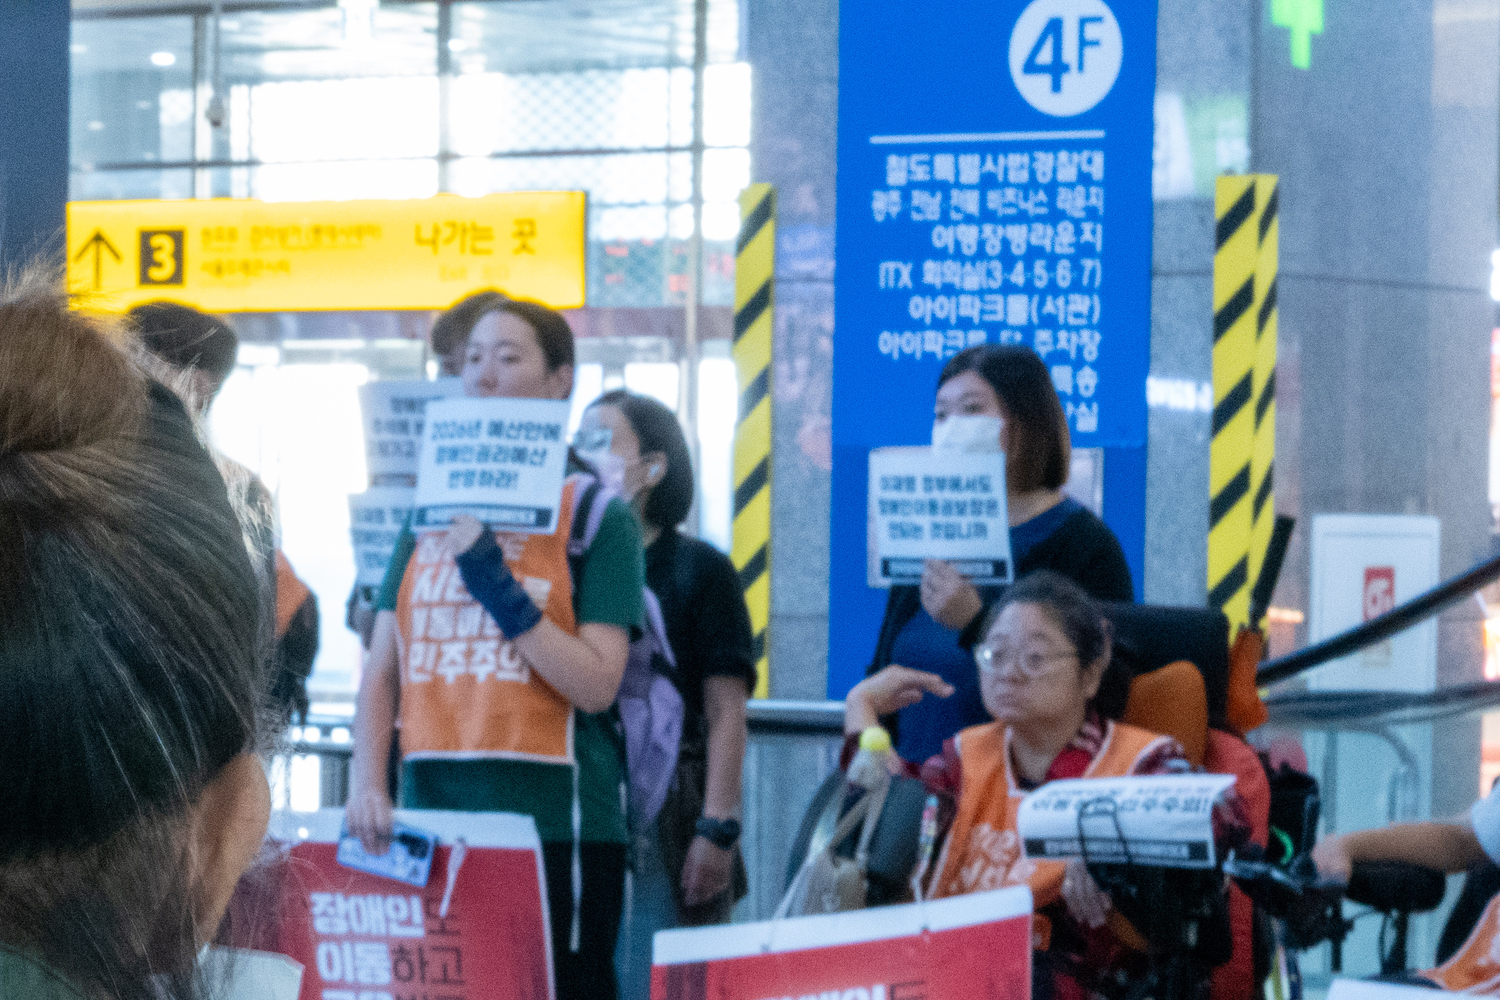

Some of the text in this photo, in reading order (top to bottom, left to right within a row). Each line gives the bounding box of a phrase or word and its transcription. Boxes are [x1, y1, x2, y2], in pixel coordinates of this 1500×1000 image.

[1021, 15, 1105, 94] 4F
[147, 233, 177, 282] 3
[414, 220, 494, 256] 나가는
[511, 217, 537, 256] 곳
[316, 941, 466, 985] 이동하고
